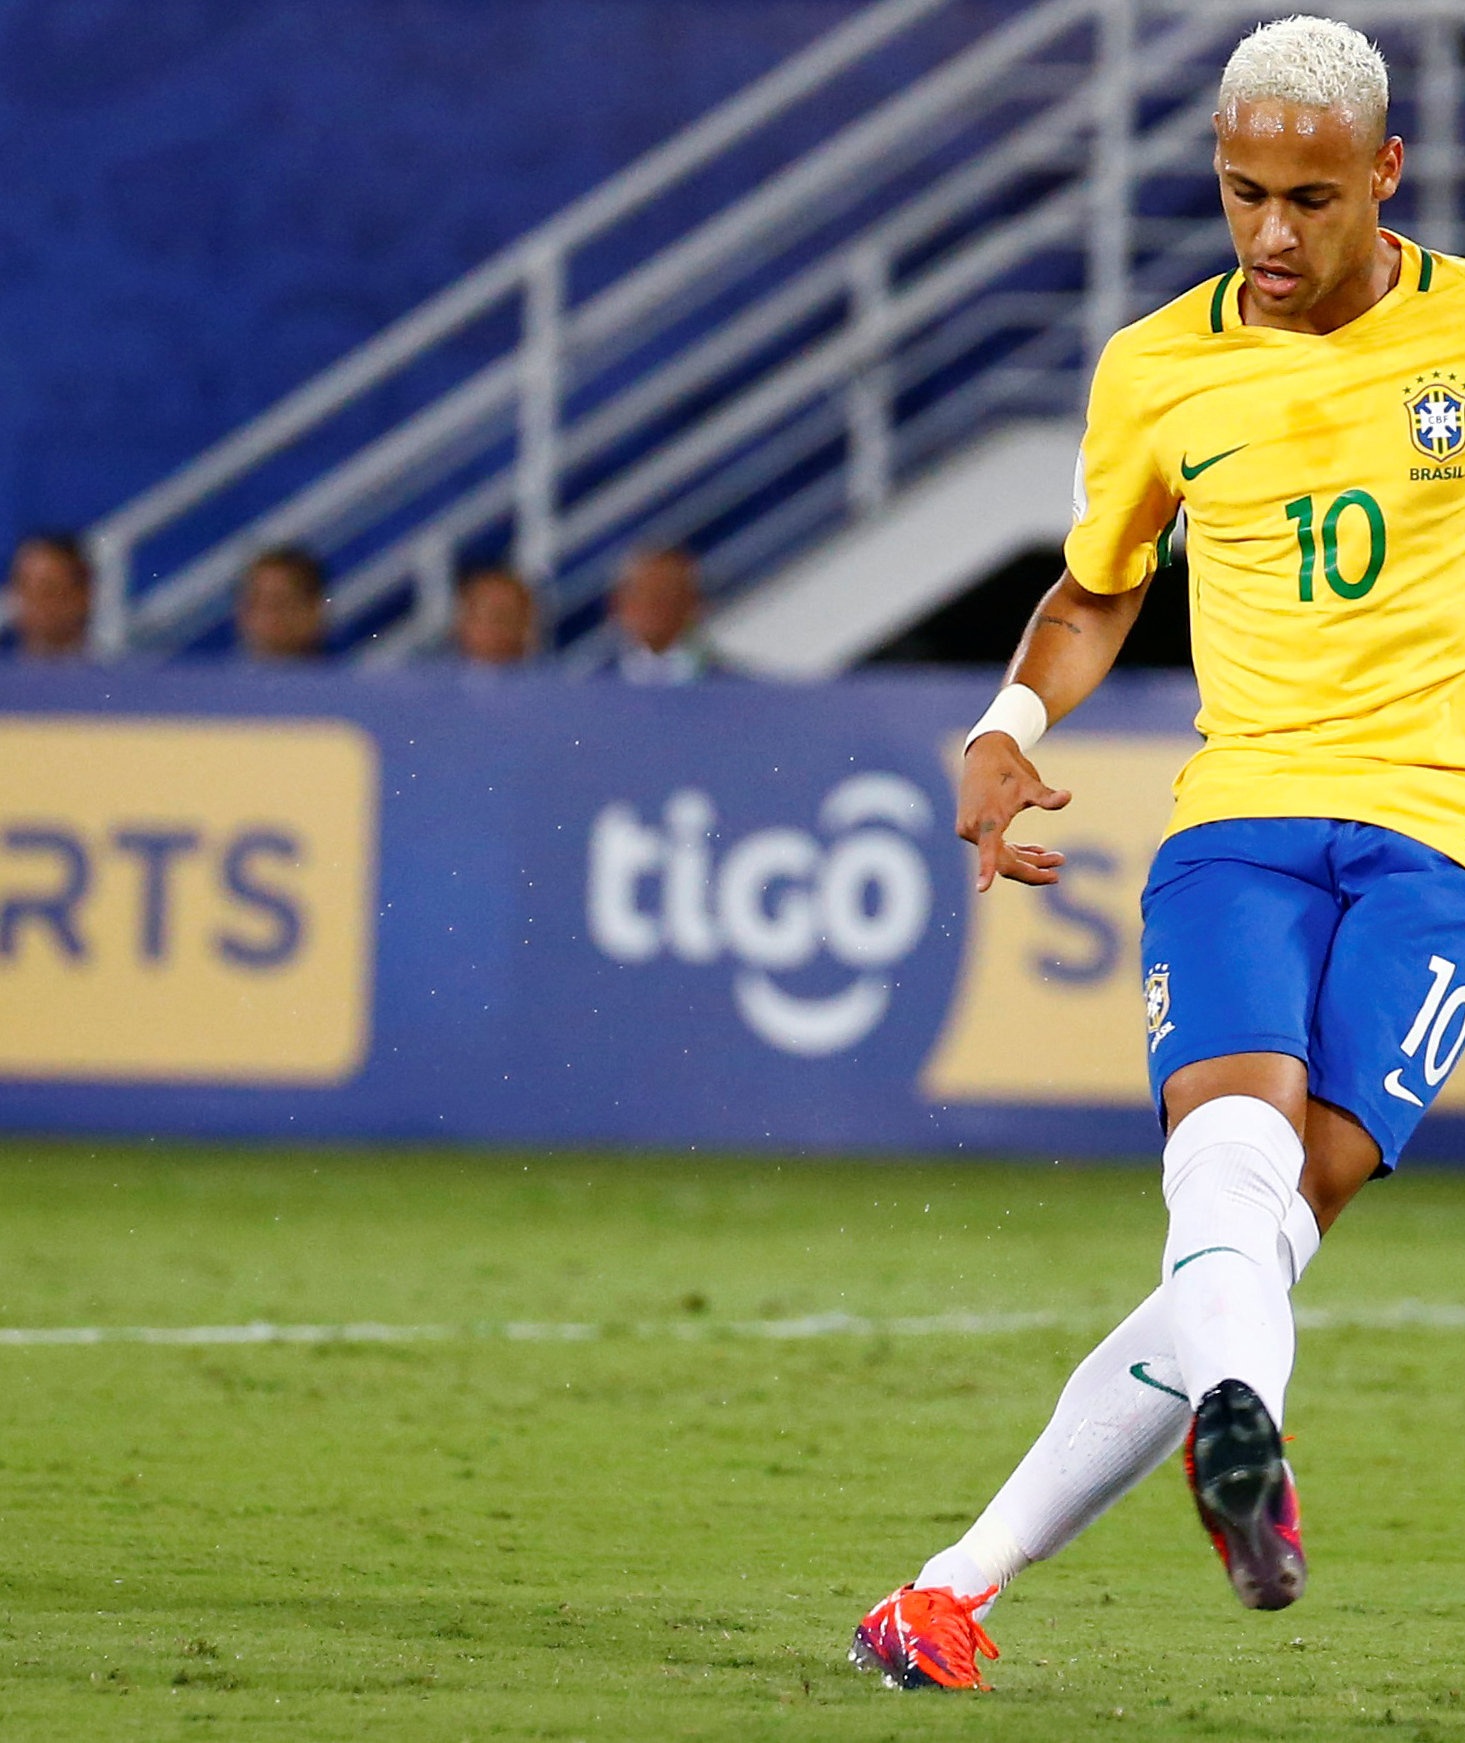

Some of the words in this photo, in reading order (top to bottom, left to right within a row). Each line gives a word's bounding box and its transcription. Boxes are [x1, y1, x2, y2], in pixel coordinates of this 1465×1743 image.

[1428, 415, 1449, 425] CBF
[1409, 466, 1463, 481] BRASIL
[1285, 488, 1386, 602] 10
[588, 772, 932, 1054] tigo
